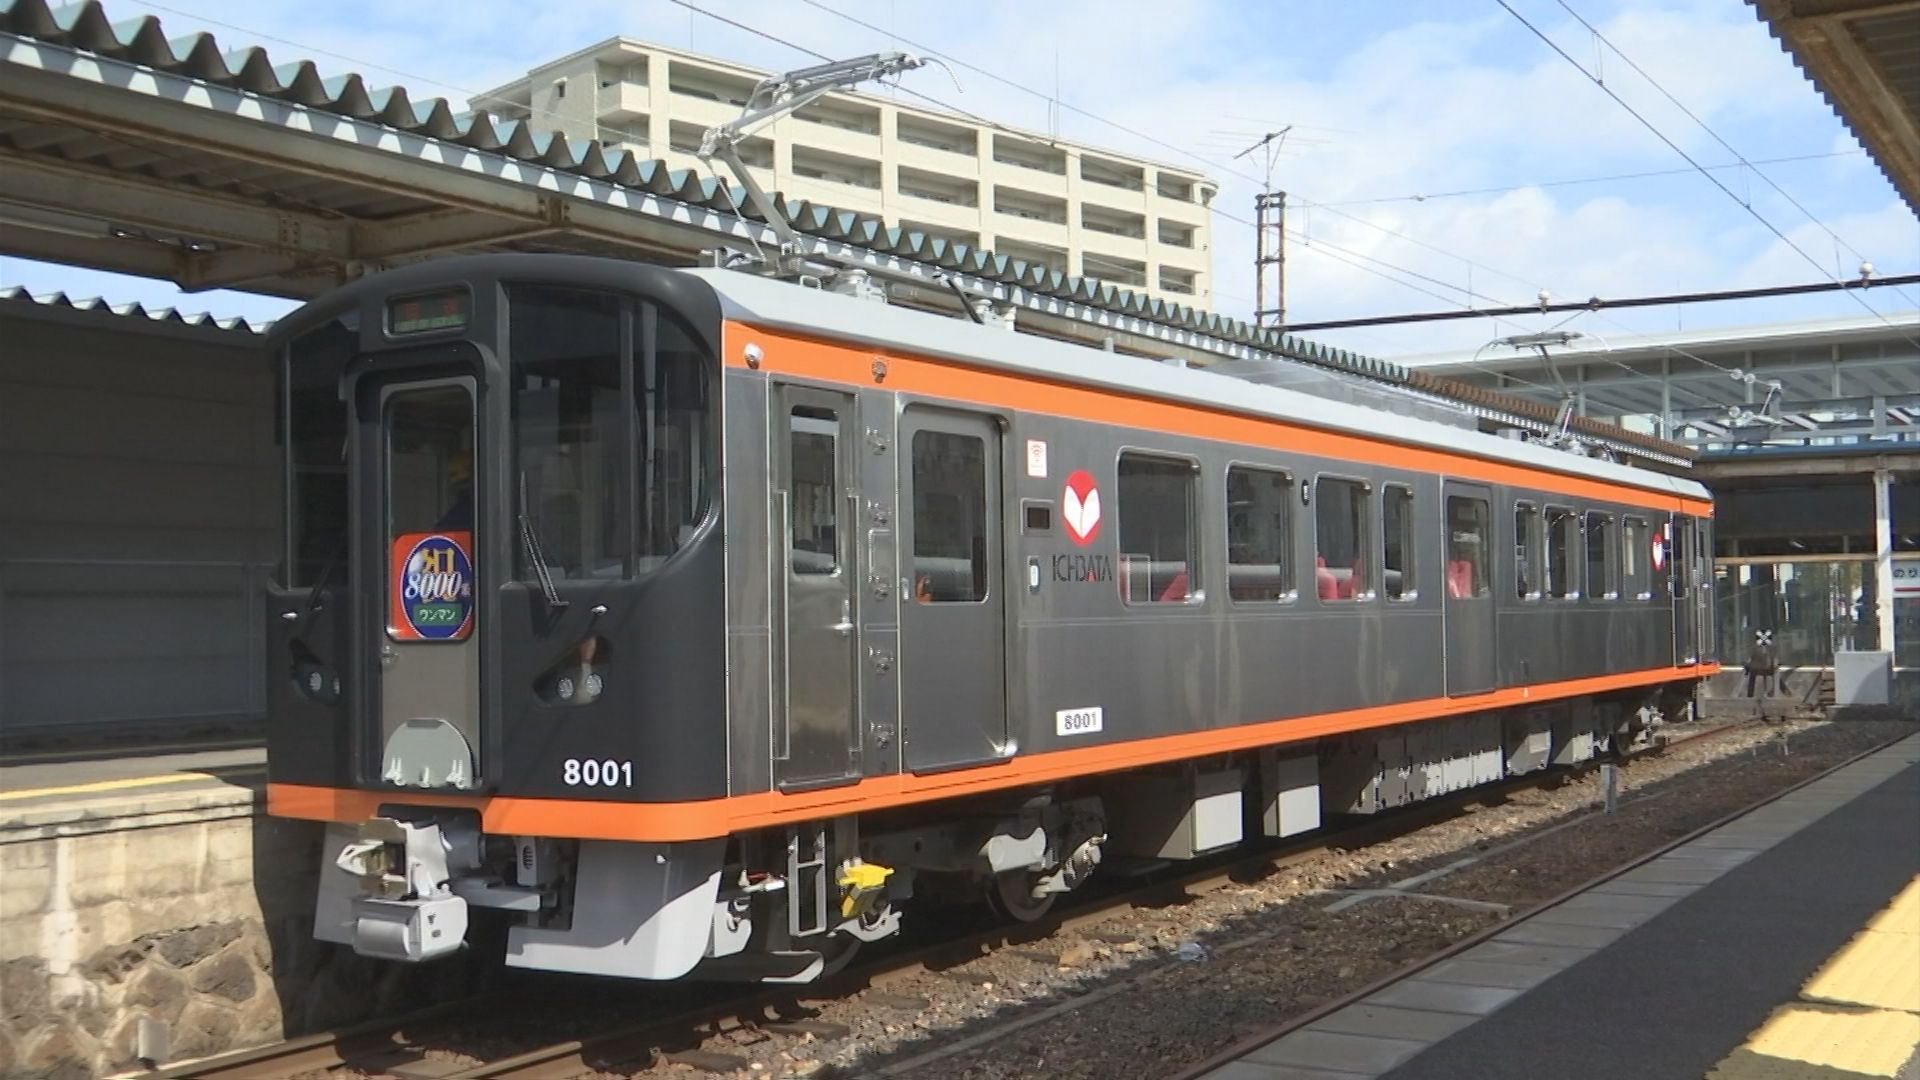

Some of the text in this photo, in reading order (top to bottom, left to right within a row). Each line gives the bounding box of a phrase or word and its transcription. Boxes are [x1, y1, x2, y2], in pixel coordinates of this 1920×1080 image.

[419, 608, 456, 621] ワンマン
[1064, 711, 1097, 730] 8001
[563, 758, 632, 788] 8001
